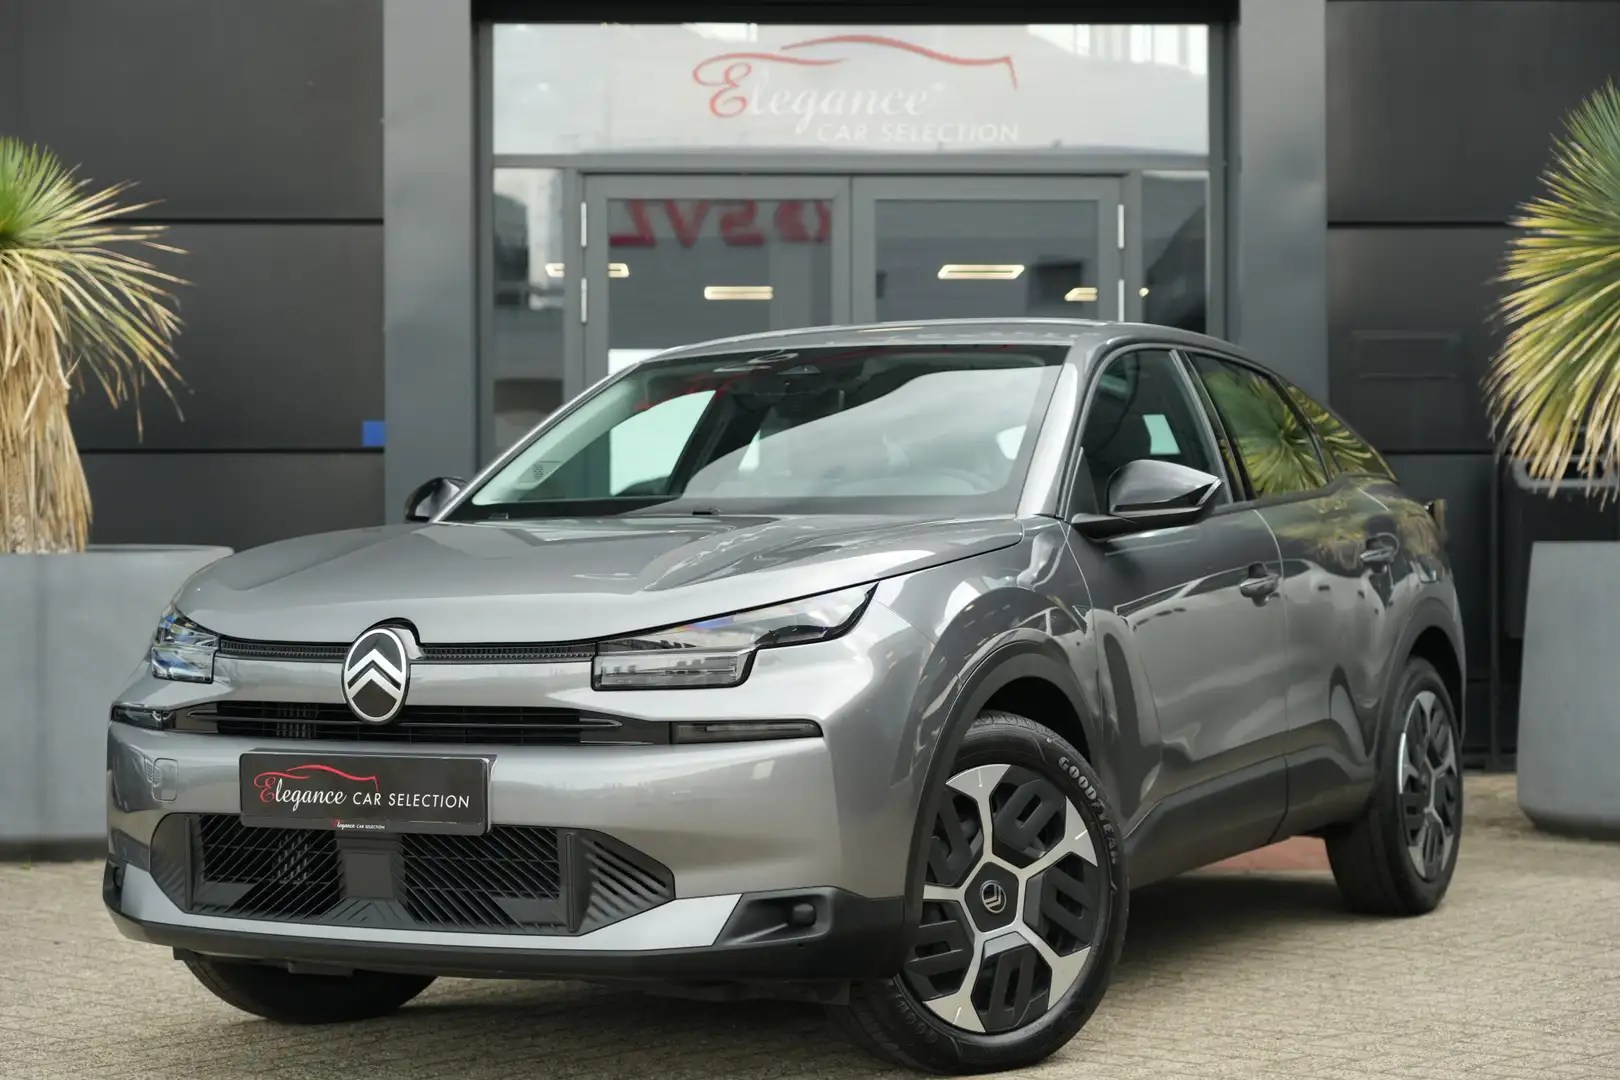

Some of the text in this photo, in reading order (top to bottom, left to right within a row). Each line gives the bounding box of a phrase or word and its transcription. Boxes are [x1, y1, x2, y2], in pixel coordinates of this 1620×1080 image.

[693, 54, 927, 135] Elegance
[816, 122, 1019, 143] CAR SELECTION
[254, 773, 470, 811] Elegance CAR SELECTION
[1058, 756, 1118, 865] GOODYEAR
